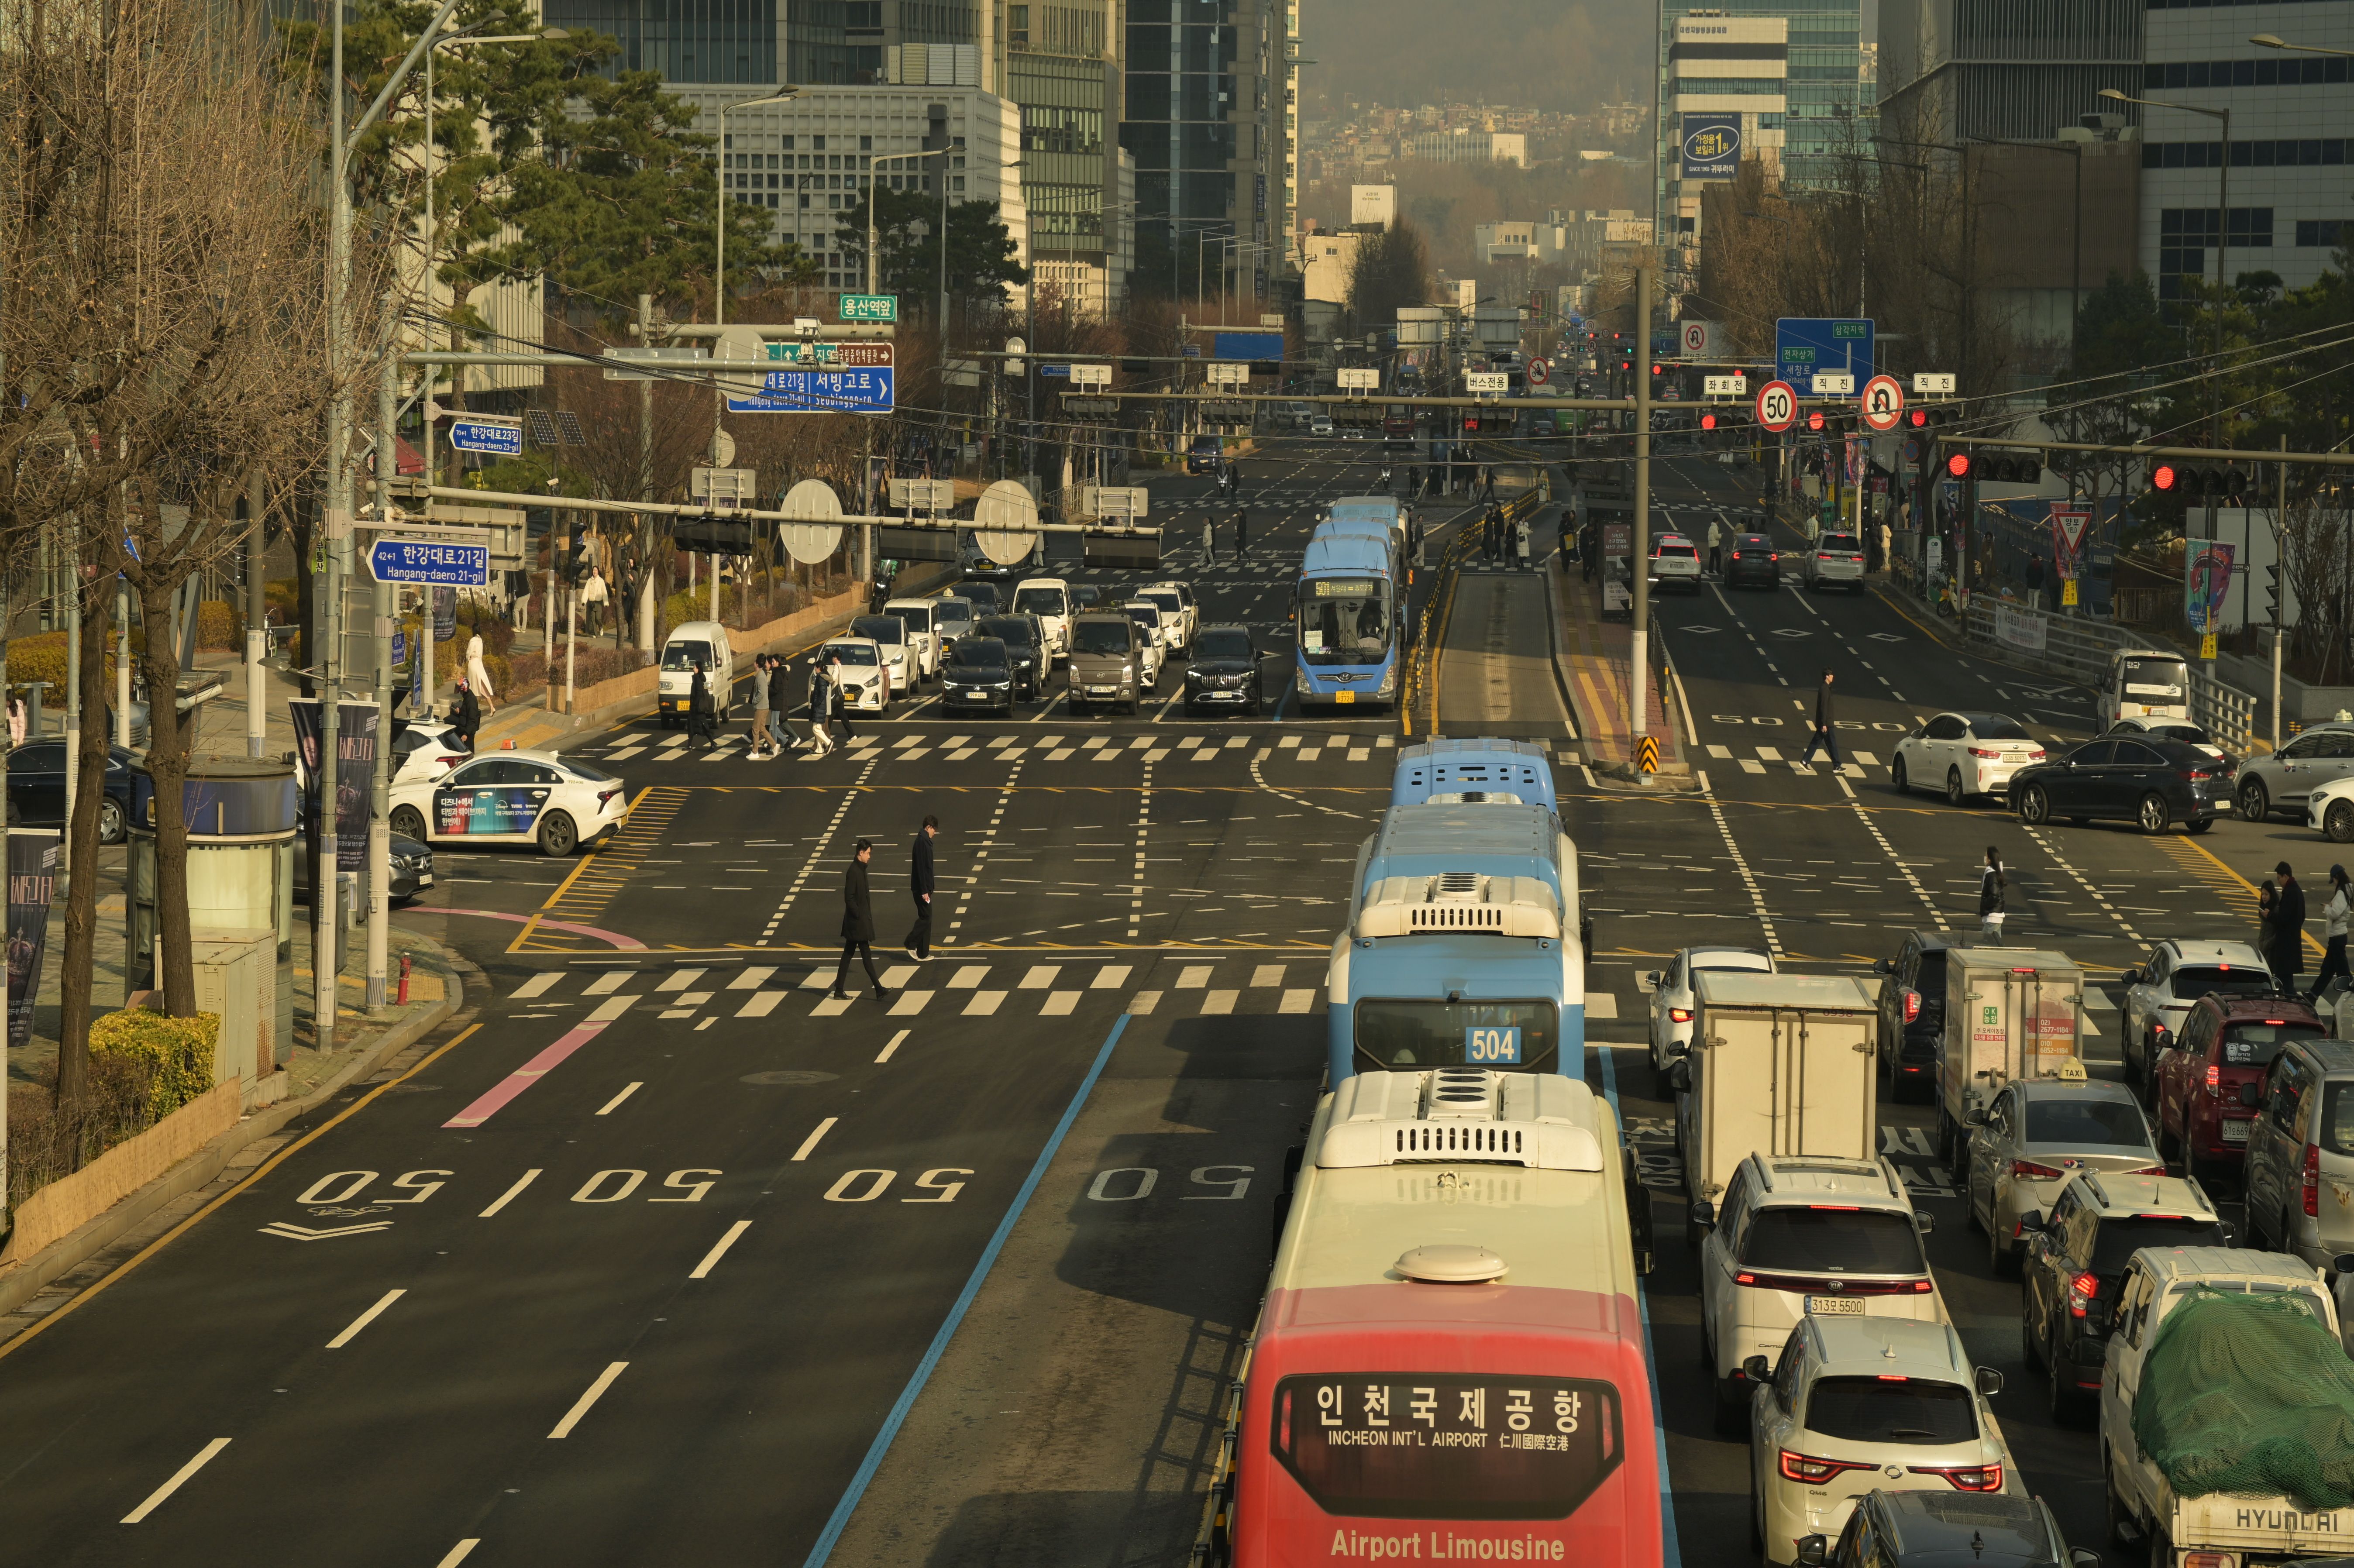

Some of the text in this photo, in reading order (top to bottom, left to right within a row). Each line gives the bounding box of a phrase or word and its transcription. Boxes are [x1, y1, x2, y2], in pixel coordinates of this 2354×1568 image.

[1695, 134, 1715, 145] 가정용
[1695, 144, 1714, 155] 보일러
[1710, 164, 1735, 174] 귀뚜라미
[844, 299, 891, 316] 용산역앞
[1835, 325, 1865, 336] 삼각지역
[839, 349, 878, 364] 국립중앙박물관
[1784, 350, 1814, 360] 전자상가
[1786, 365, 1811, 377] 새창로
[816, 373, 872, 392] 서빙고로
[1469, 376, 1505, 389] 버스전용
[816, 394, 872, 408] Seobinggo-ro
[1767, 394, 1788, 419] 50
[471, 427, 519, 443] 한강대로23길
[461, 439, 519, 452] Hangang-daero 23-gil
[2065, 517, 2079, 526] 양보
[378, 552, 387, 560] 42
[403, 546, 484, 568] 한강대로21길
[387, 566, 484, 584] Hangang-daero 21-gil
[1315, 581, 1330, 596] 501
[1711, 715, 1784, 726] 50
[1834, 720, 1907, 732] 50
[441, 798, 473, 807] 디즈니+에서
[441, 807, 487, 816] 티빙과 웨이브까지
[441, 817, 461, 826] 한번에!
[1823, 1009, 1853, 1018] 0938
[1983, 1015, 1997, 1024] 농장
[1472, 1029, 1514, 1061] 504
[2224, 1125, 2251, 1135] 61오669
[296, 1169, 455, 1204] 50
[570, 1168, 723, 1203] 50
[823, 1167, 976, 1203] 50
[1086, 1164, 1256, 1202] 50
[1829, 1282, 1842, 1290] KIA
[1838, 1299, 1863, 1313] 5500
[1328, 1430, 1488, 1448] INCHEON INT'L AIRPORT
[1499, 1432, 1569, 1452] 仁川國際空港
[2237, 1508, 2338, 1533] HYUNDAI
[1330, 1529, 1565, 1562] Airport Limousine
